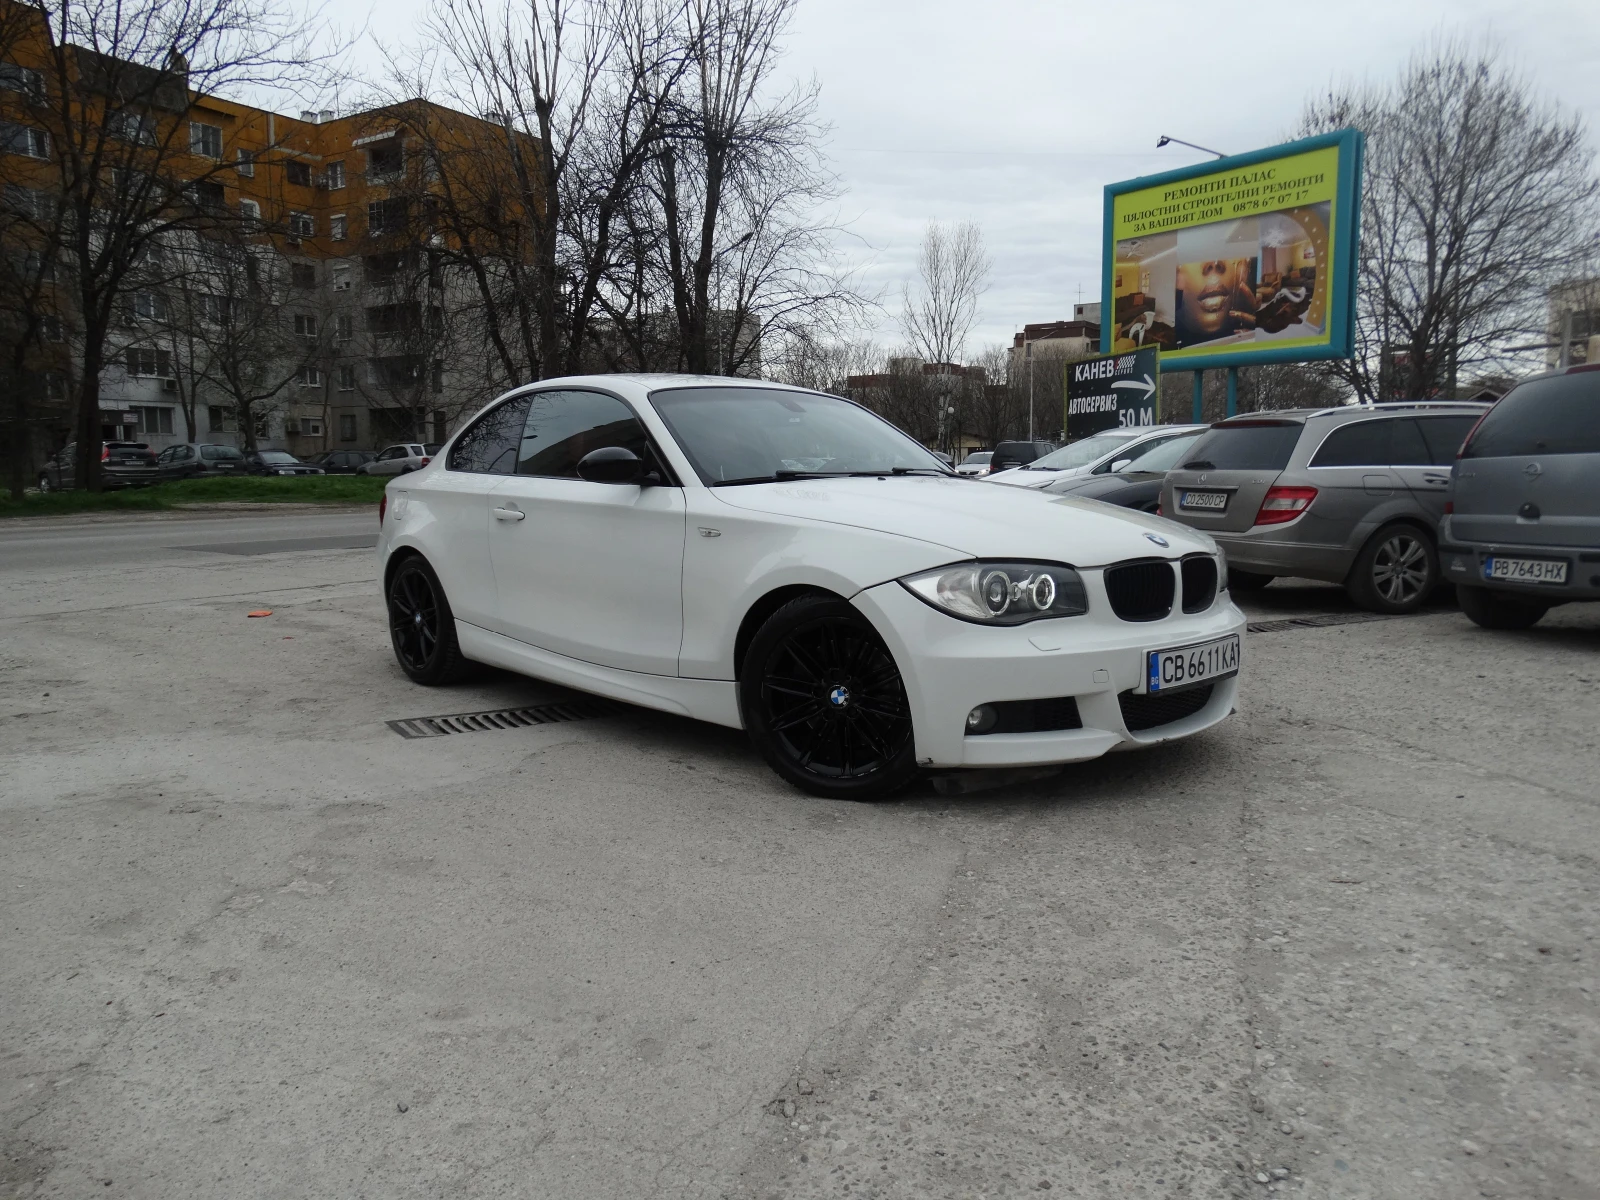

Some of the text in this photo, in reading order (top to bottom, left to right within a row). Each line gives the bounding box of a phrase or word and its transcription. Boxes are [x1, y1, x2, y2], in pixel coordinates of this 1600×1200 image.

[1164, 168, 1276, 202] РЕМОНТИ ПАЛАС
[1123, 173, 1324, 223] ЦЯЛОСТНИ СТРОИТЕЛНИ РЕМОНТИ
[1133, 189, 1309, 232] ЗА ВАШИЯТ ДОМ 0878 67 07 17
[1075, 360, 1115, 382] КАНЕВ
[1068, 394, 1117, 415] АВТОСЕРВИЗ
[1119, 408, 1136, 428] 50
[1511, 562, 1542, 578] 7643
